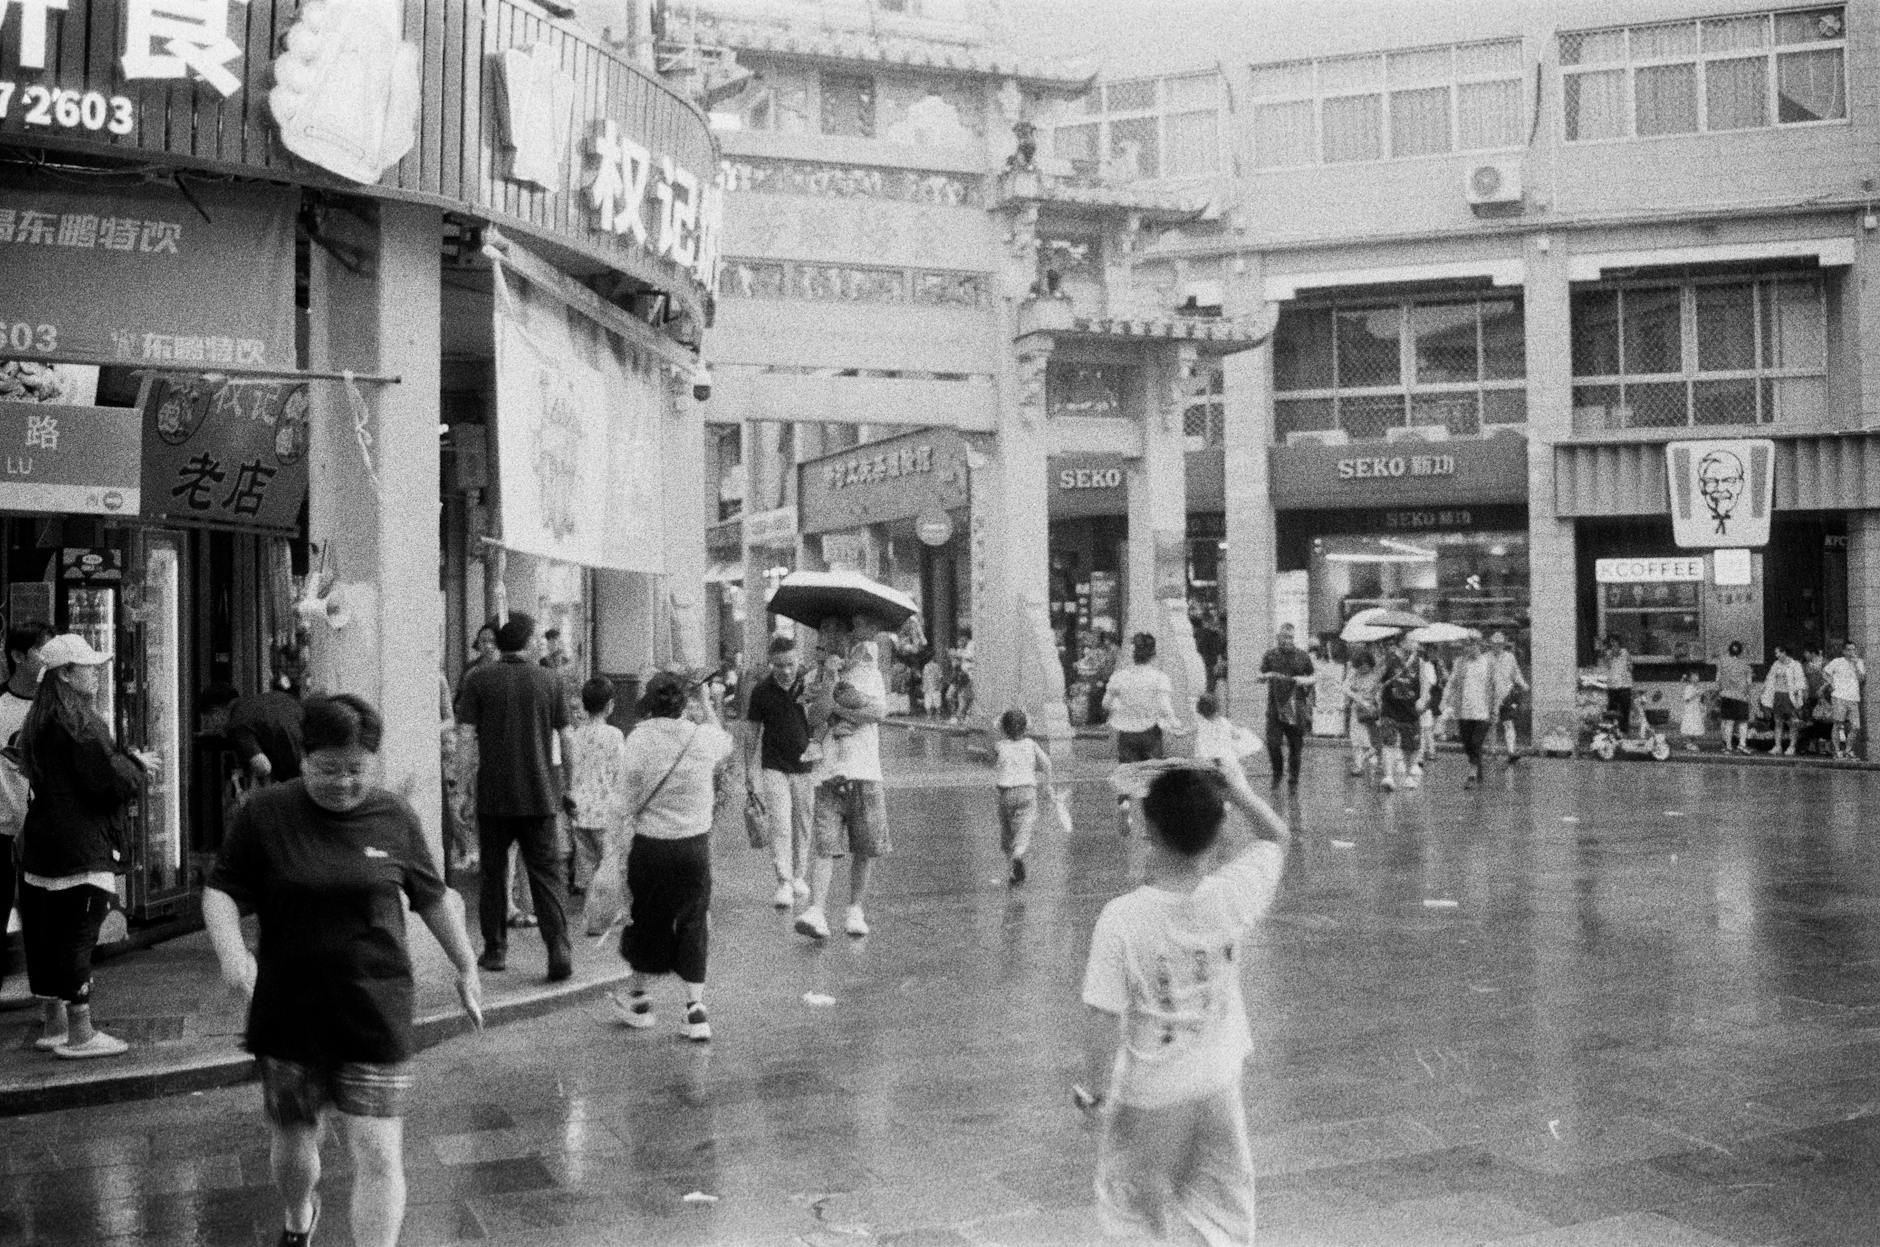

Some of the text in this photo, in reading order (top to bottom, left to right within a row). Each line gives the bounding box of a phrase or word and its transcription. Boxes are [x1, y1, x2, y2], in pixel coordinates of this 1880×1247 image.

[25, 414, 60, 450] 路
[6, 455, 33, 475] LU
[1337, 455, 1406, 479] SEKO
[171, 451, 277, 517] 老店
[1058, 467, 1122, 489] SEKO
[1824, 534, 1848, 547] KFC
